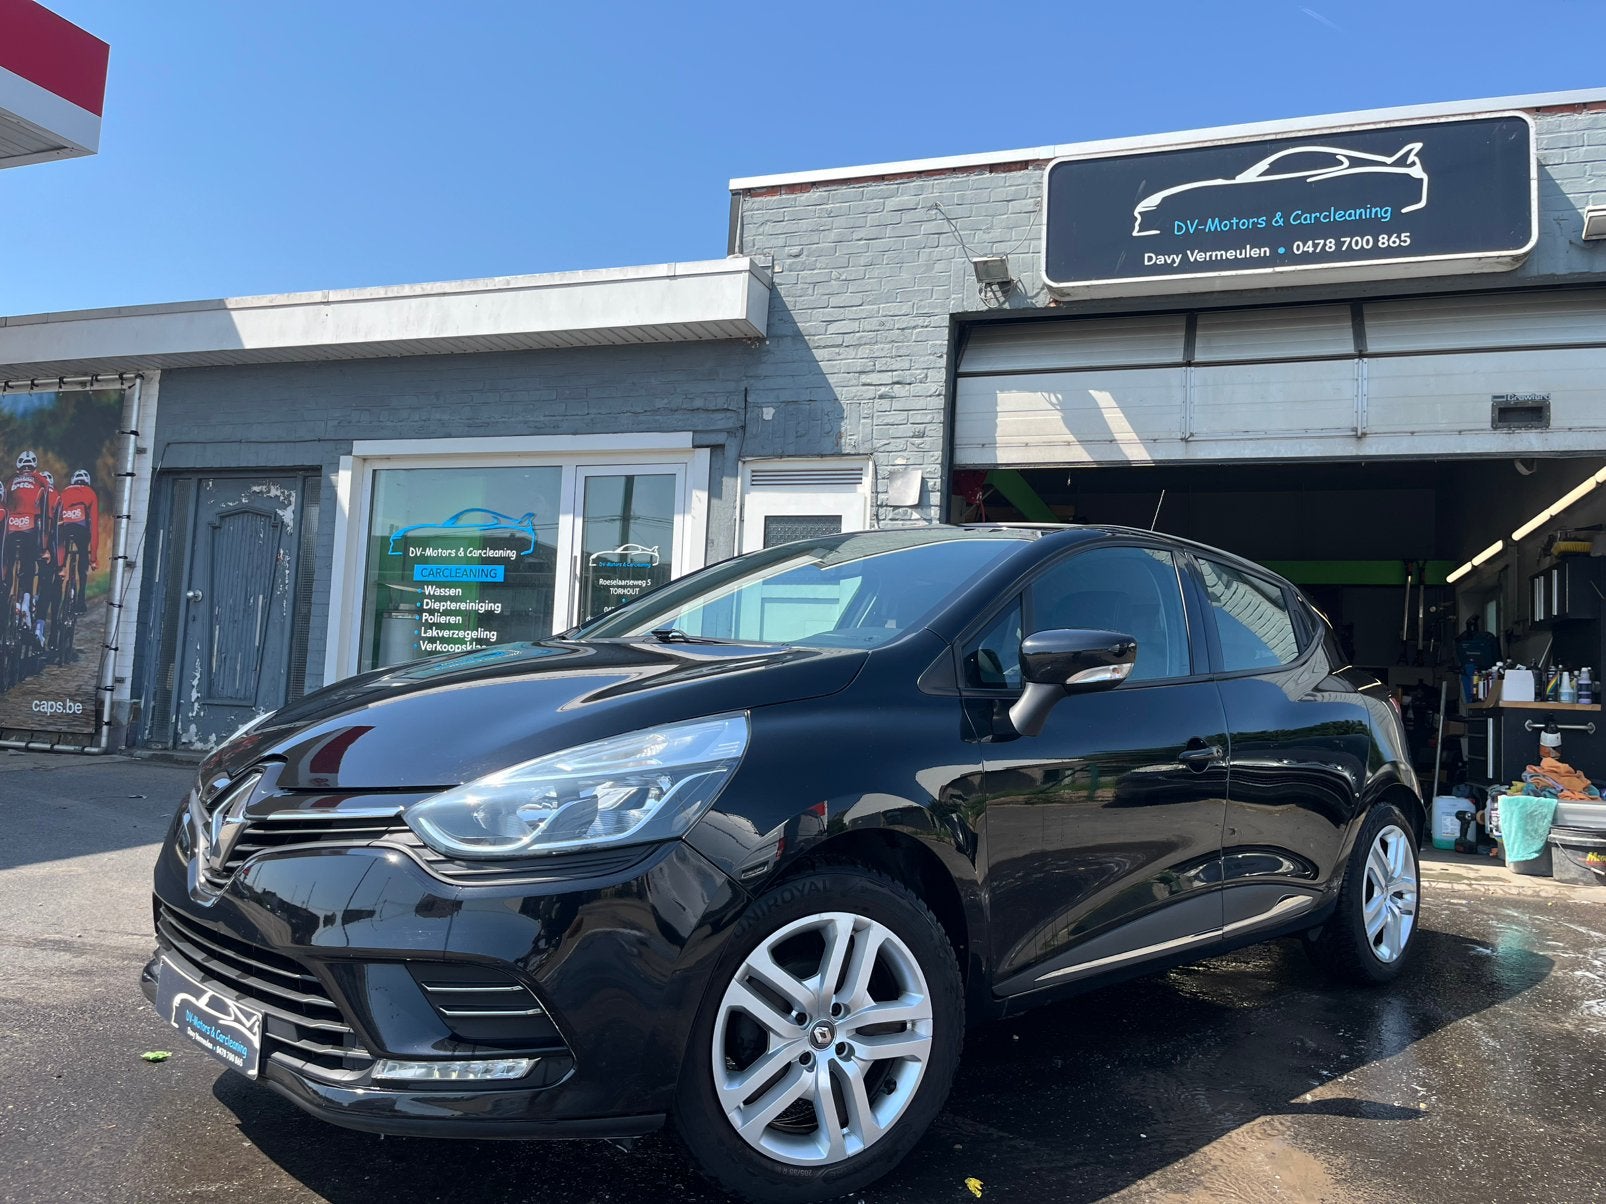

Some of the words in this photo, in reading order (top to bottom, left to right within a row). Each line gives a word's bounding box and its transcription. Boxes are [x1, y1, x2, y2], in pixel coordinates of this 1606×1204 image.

[1174, 216, 1267, 235] DV-Motors
[1272, 211, 1284, 227] &
[1290, 205, 1392, 225] Carcleaning
[1144, 252, 1182, 267] Davy
[1186, 244, 1270, 263] Vermeulen
[1293, 238, 1336, 255] 0478
[1340, 235, 1373, 251] 700
[1378, 232, 1411, 248] 865
[8, 516, 30, 528] caps
[409, 547, 456, 557] DV-Motors
[457, 547, 464, 557] &
[466, 547, 517, 560] Carcleaning
[420, 567, 498, 579] CARCLEANING
[599, 579, 646, 587] Roeselaarseweg
[424, 585, 462, 596] Wassen
[423, 599, 502, 613] Dieptereiniging
[422, 612, 462, 624] Polieren
[421, 626, 497, 642] Lakverzegeling
[32, 698, 83, 716] caps.be
